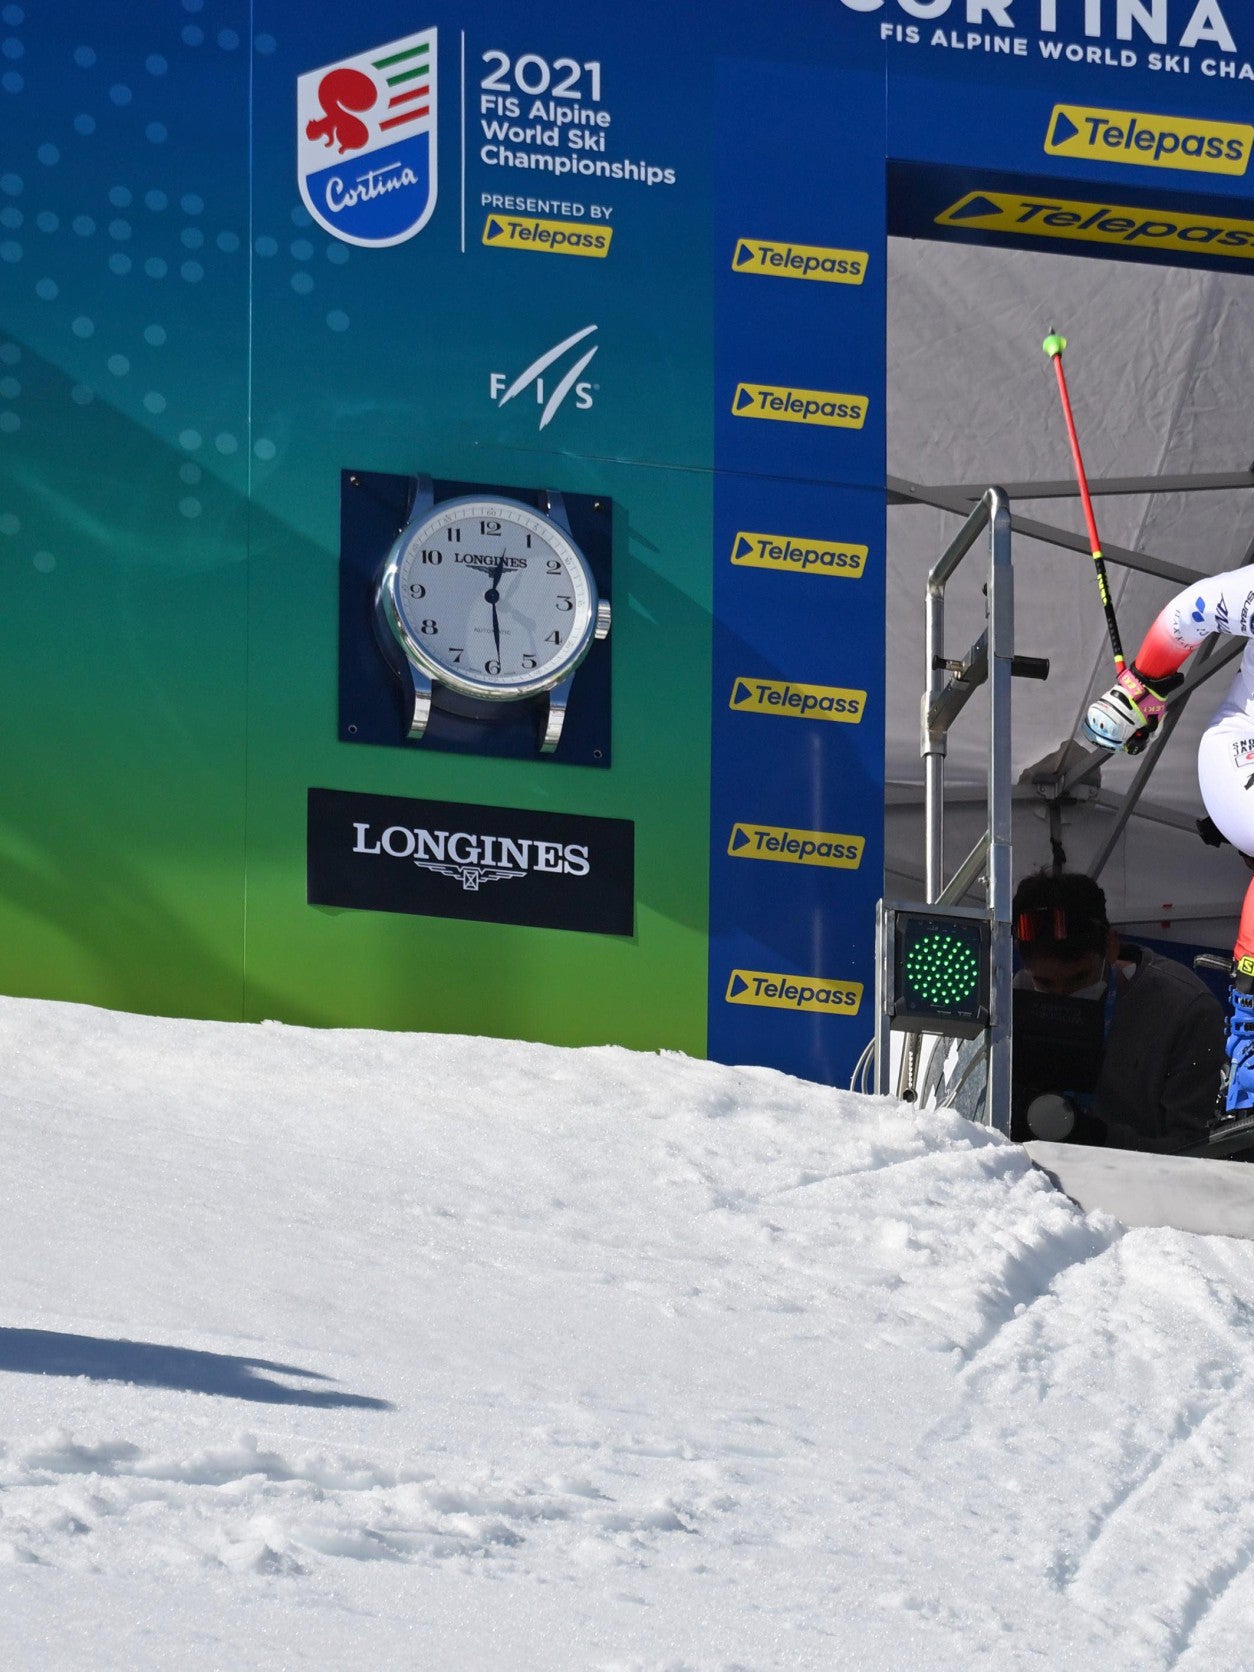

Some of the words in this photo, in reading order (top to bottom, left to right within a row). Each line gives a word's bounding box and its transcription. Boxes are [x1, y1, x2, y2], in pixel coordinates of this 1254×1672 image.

[881, 23, 920, 43] FIS
[931, 29, 1028, 56] ALPINE
[1039, 41, 1137, 68] WORLD
[1148, 53, 1190, 73] SKI
[480, 51, 601, 101] 2021
[481, 95, 520, 118] FIS
[529, 100, 611, 128] Alpine
[480, 120, 558, 147] World
[567, 130, 605, 152] Ski
[1085, 117, 1244, 161] Telepass
[480, 146, 676, 185] Championships
[325, 162, 418, 213] Cortina
[481, 194, 585, 217] PRESENTED
[590, 203, 614, 220] BY
[507, 222, 606, 250] Telepass
[758, 247, 861, 276] Telepass
[758, 391, 861, 420] Telepass
[447, 528, 461, 543] 11
[480, 520, 502, 537] 12
[526, 534, 532, 549] 1
[421, 550, 443, 565] 10
[454, 553, 528, 569] LONGINES
[546, 560, 562, 575] 2
[757, 540, 861, 569] Telepass
[410, 584, 426, 600] 9
[556, 595, 573, 612] 3
[421, 619, 438, 636] 8
[544, 630, 563, 645] 4
[448, 647, 464, 664] 7
[484, 659, 501, 676] 6
[522, 653, 537, 669] 5
[756, 685, 859, 714] Telepass
[353, 822, 590, 876] LONGINES
[754, 831, 858, 860] Telepass
[752, 977, 856, 1007] Telepass
